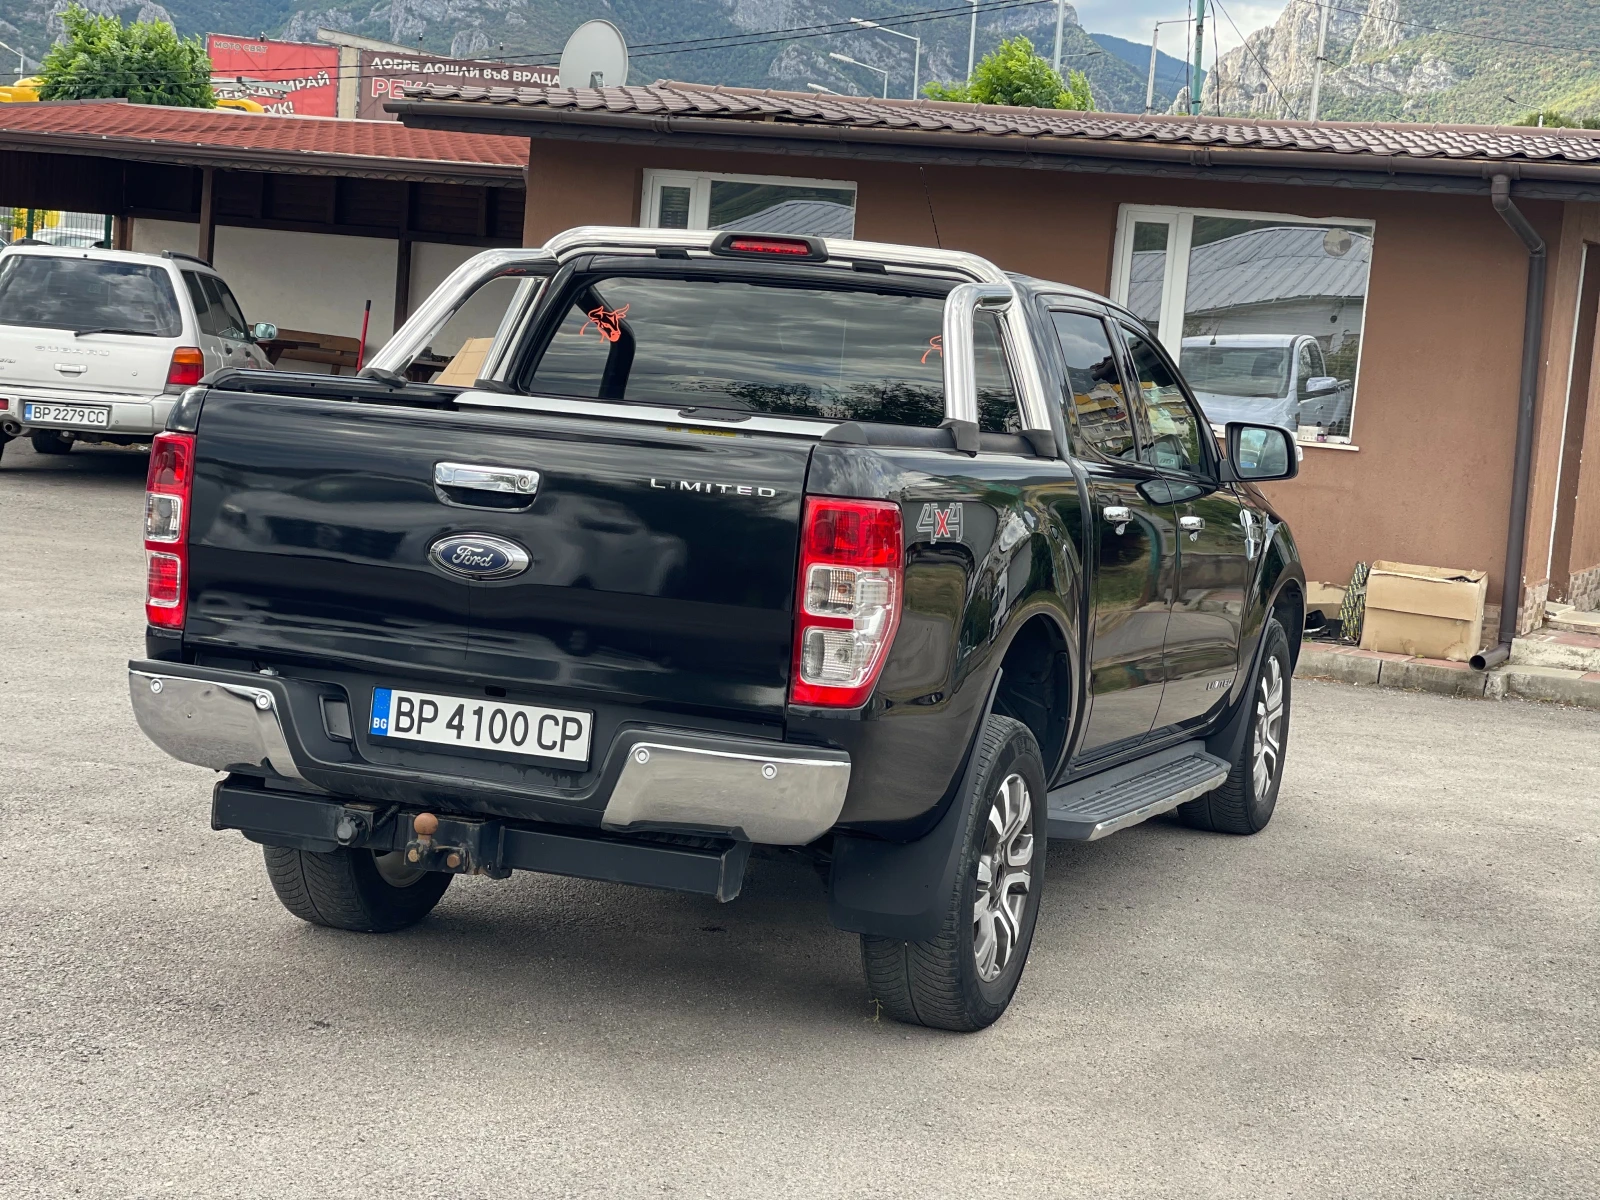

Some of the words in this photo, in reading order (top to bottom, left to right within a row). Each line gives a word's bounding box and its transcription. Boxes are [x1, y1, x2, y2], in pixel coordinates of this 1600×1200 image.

[214, 41, 241, 50] МОТО
[243, 44, 268, 53] СВЯТ
[370, 57, 420, 72] ДОБРЕ
[422, 63, 480, 77] ДОШЛИ
[483, 69, 509, 80] във
[512, 71, 560, 86] ВРАЦА
[35, 345, 109, 356] SUBARU
[33, 406, 51, 419] BP
[53, 409, 85, 422] 2279
[87, 411, 105, 423] CC
[650, 478, 776, 498] LIMITED
[452, 545, 494, 567] Ford
[373, 717, 387, 729] BG
[394, 696, 438, 734] BP
[445, 703, 529, 746] 4100
[536, 714, 583, 752] CP
